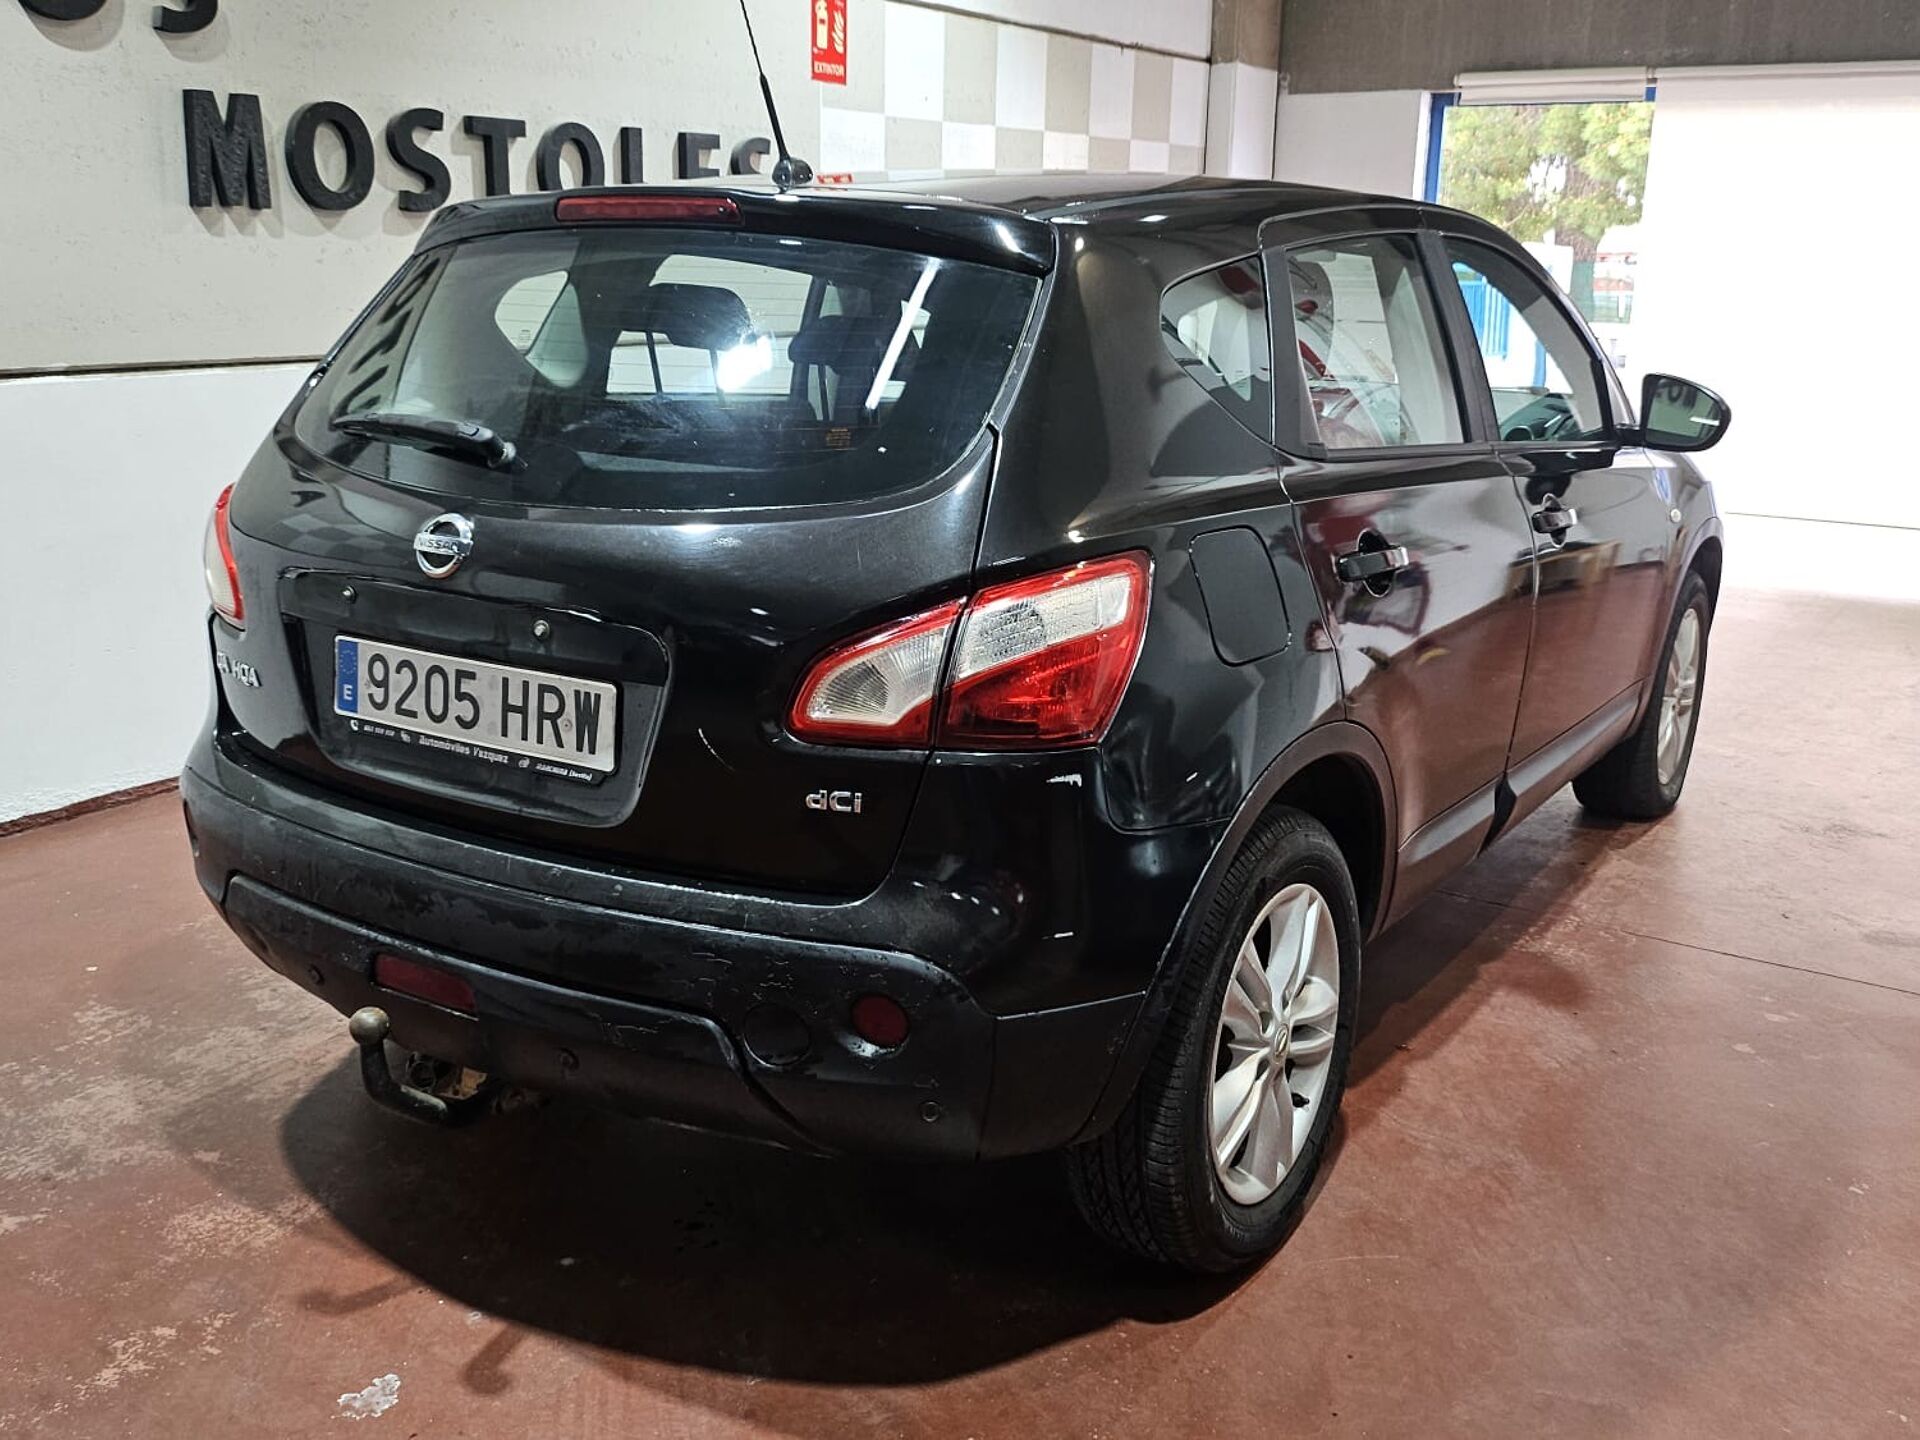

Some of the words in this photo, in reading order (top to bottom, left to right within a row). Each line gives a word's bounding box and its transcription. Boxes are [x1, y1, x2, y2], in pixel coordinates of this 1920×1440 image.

[342, 683, 353, 701] E
[367, 652, 480, 730] 9205
[501, 676, 601, 755] HRW
[805, 789, 862, 814] dCi
